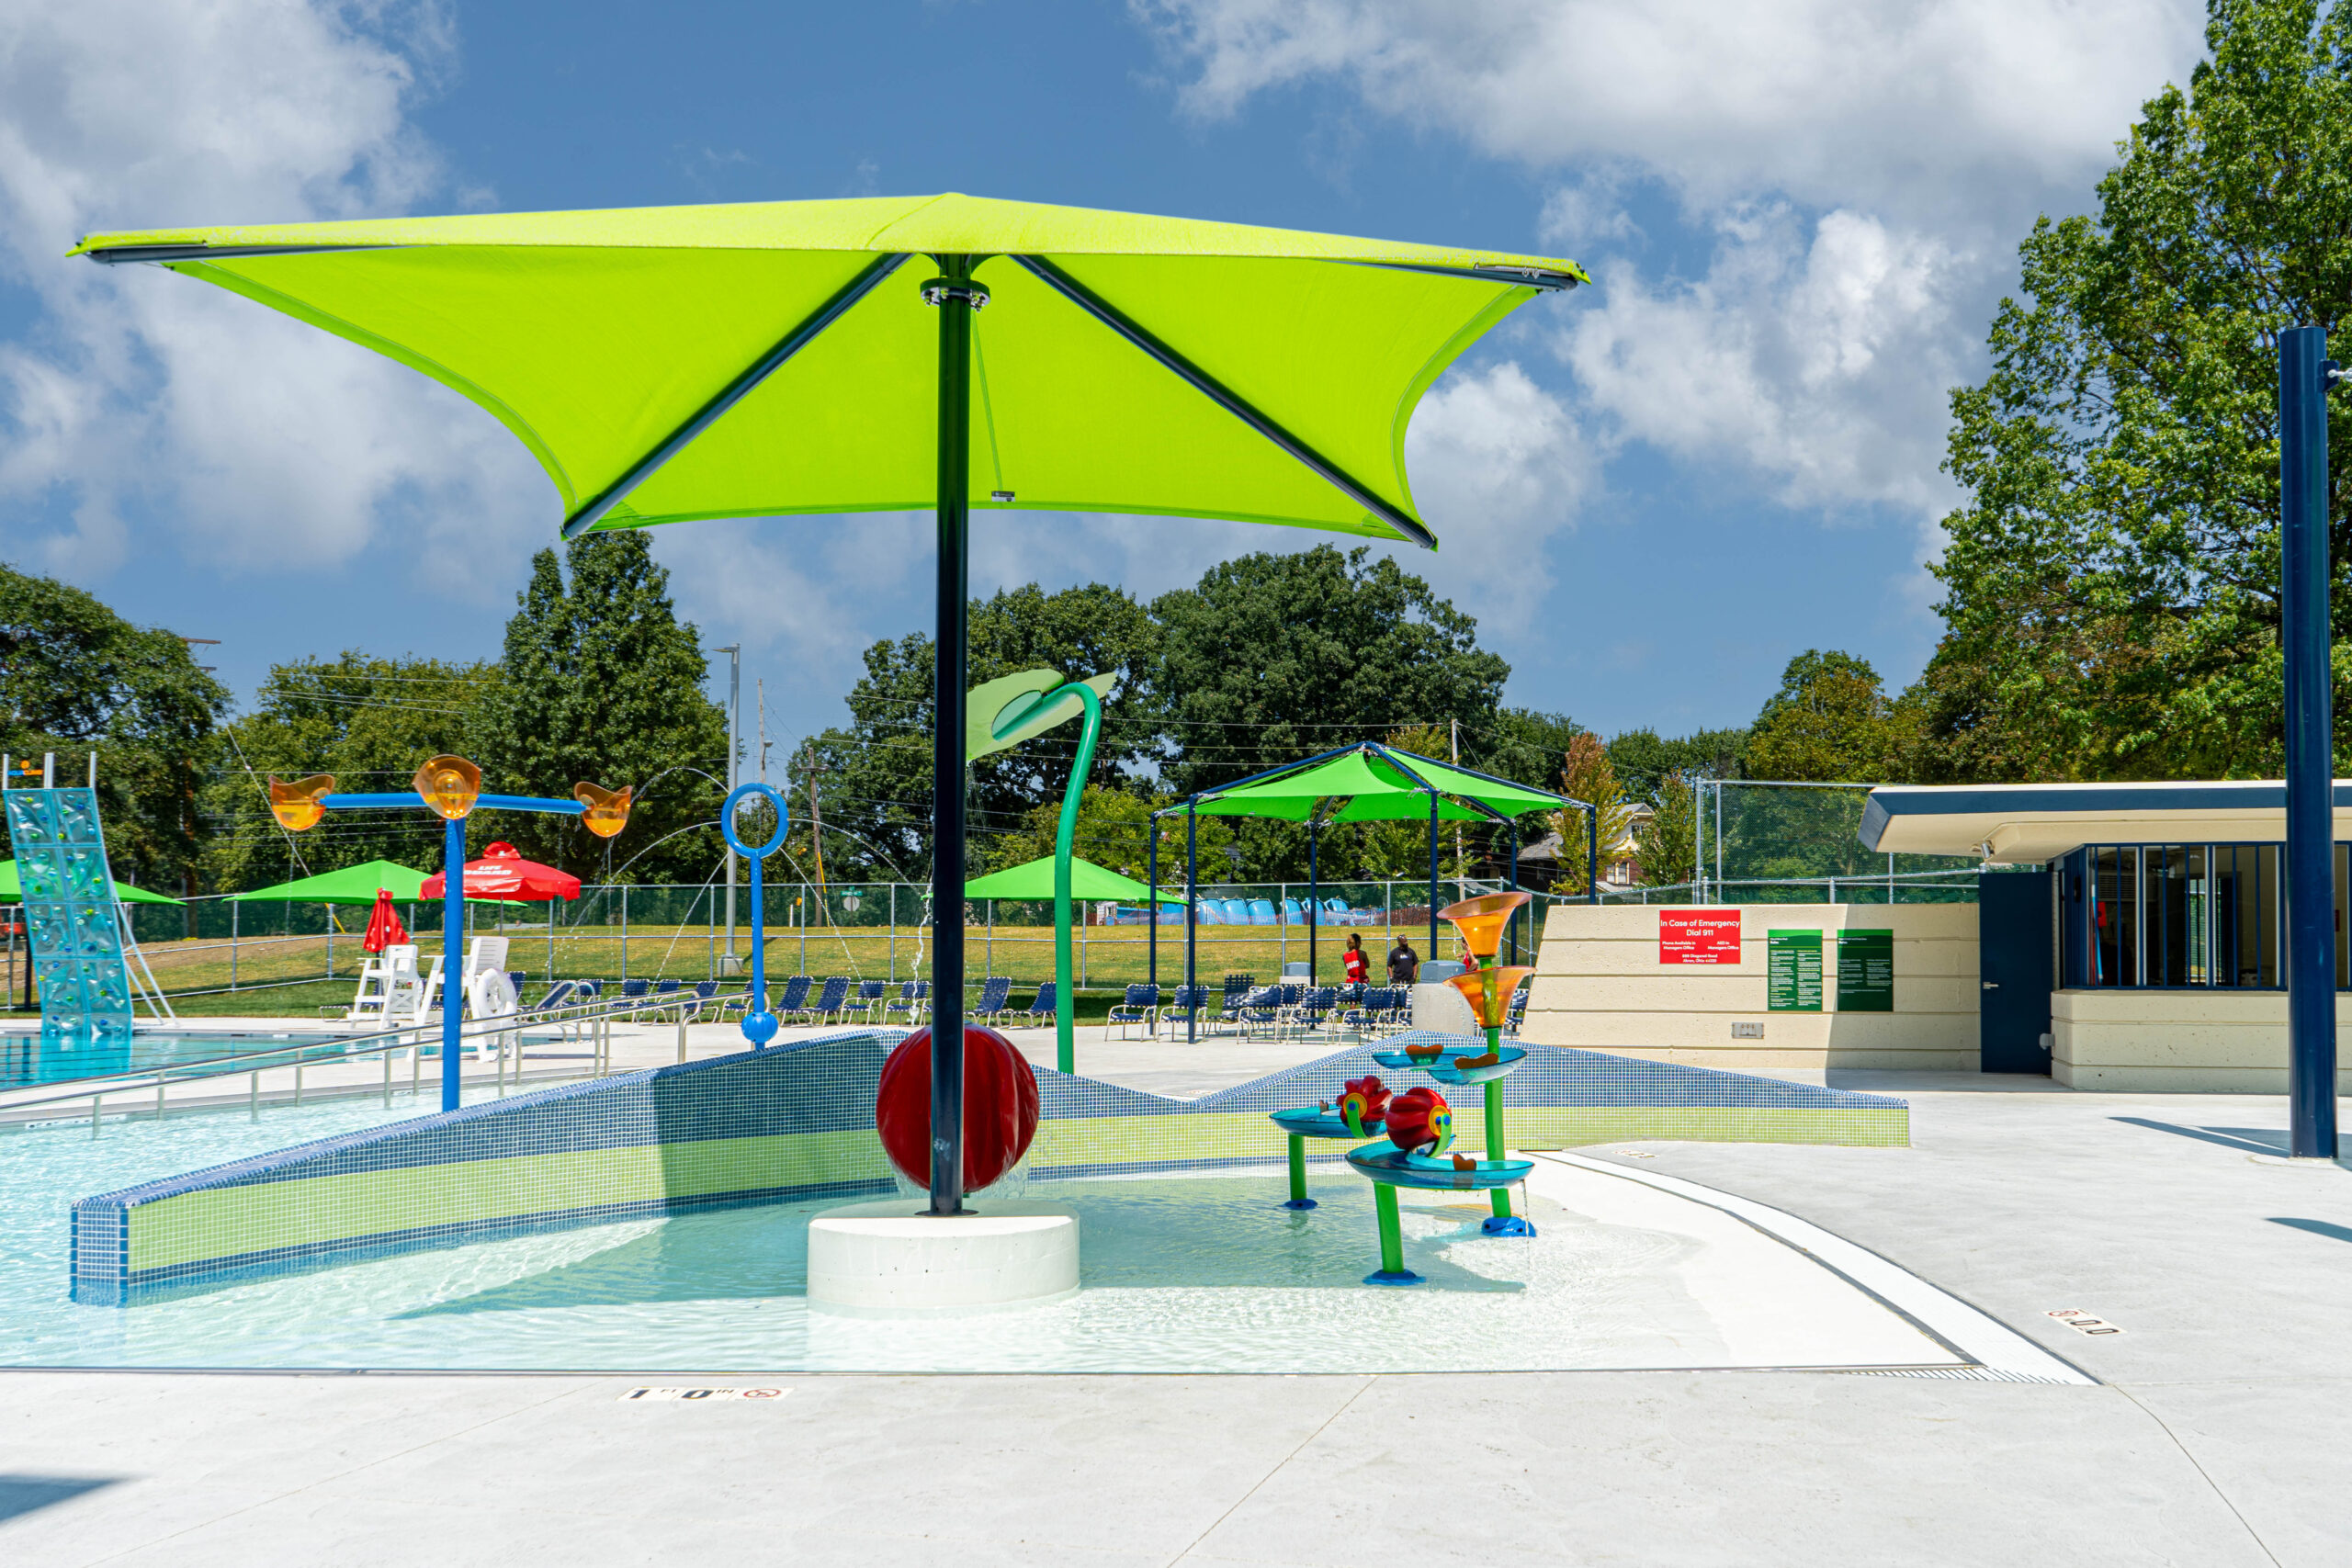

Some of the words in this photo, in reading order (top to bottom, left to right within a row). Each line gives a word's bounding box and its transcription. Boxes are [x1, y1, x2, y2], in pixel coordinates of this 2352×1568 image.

[1698, 919, 1740, 929] Emergency
[629, 1389, 650, 1399] 1
[681, 1389, 714, 1400] 0
